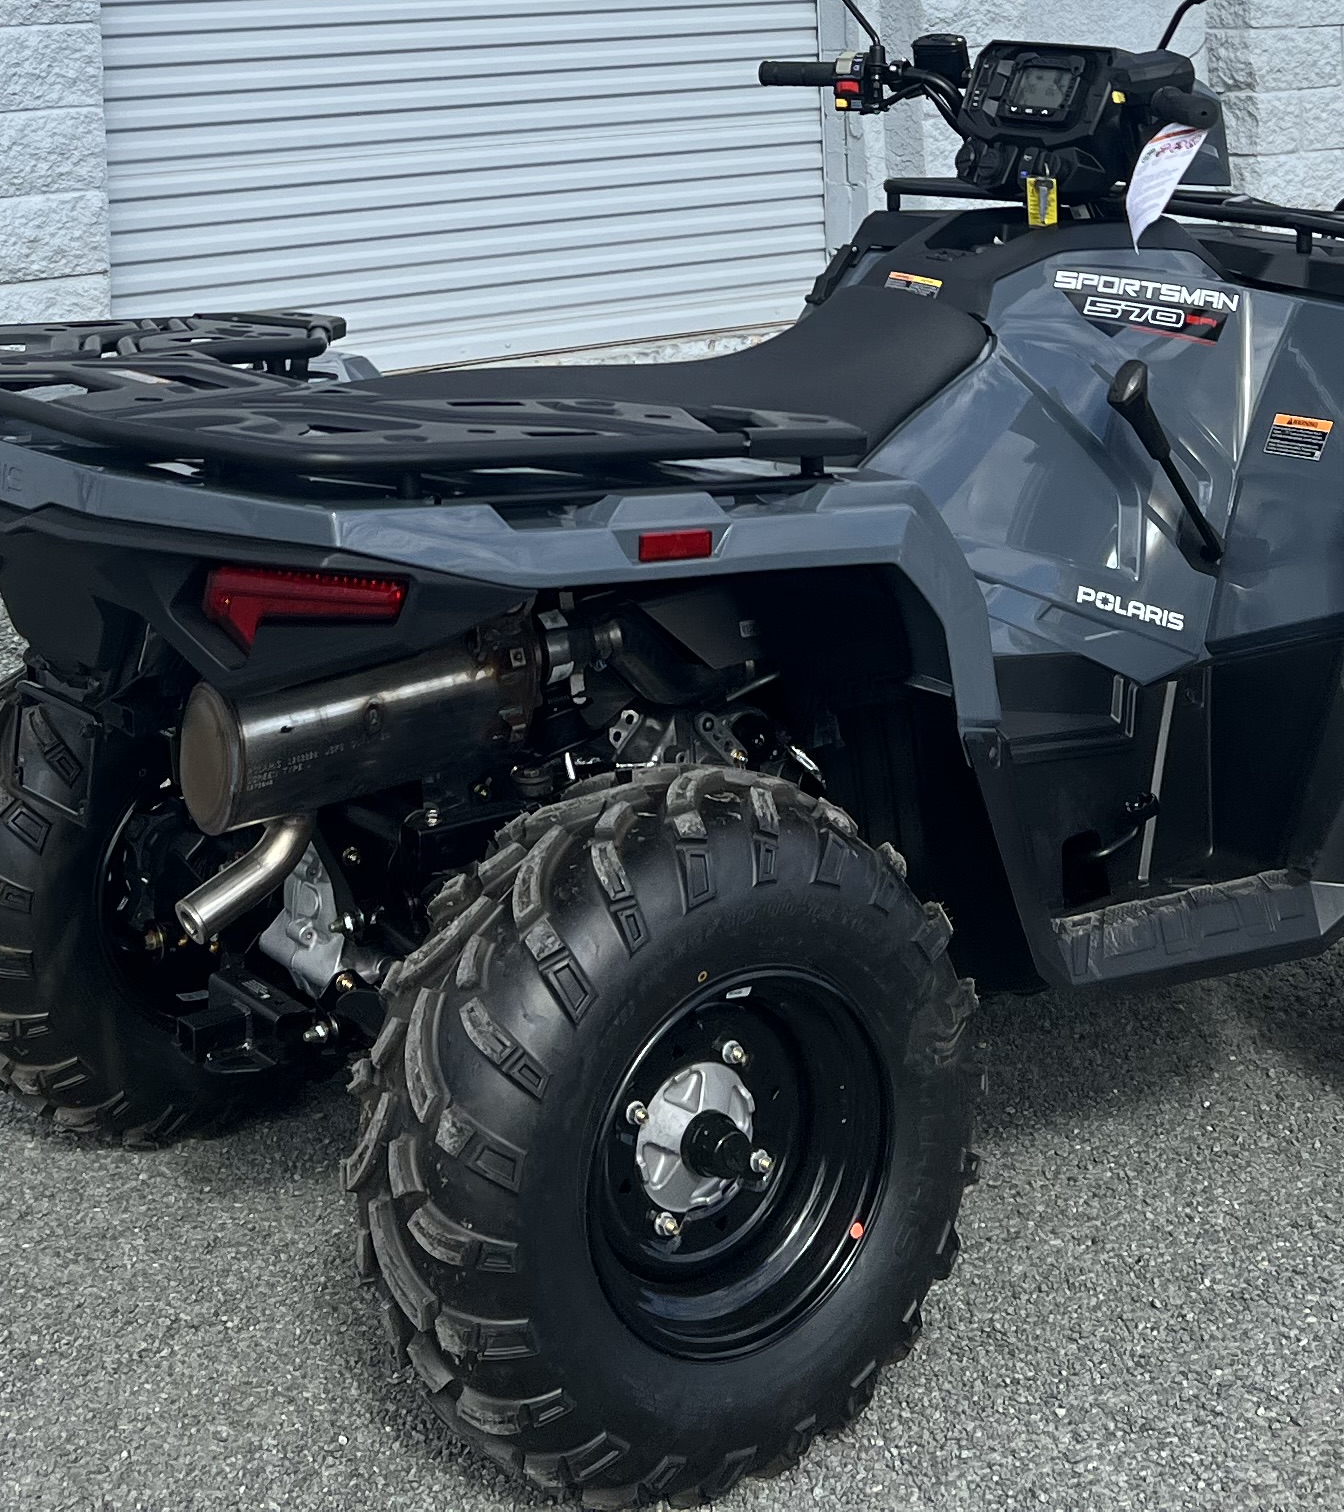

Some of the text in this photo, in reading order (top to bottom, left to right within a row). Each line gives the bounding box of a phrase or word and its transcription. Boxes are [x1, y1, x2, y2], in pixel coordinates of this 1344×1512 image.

[1053, 270, 1240, 313] SPORTSMAN
[1083, 295, 1185, 329] 570
[1077, 585, 1185, 631] POLARIS
